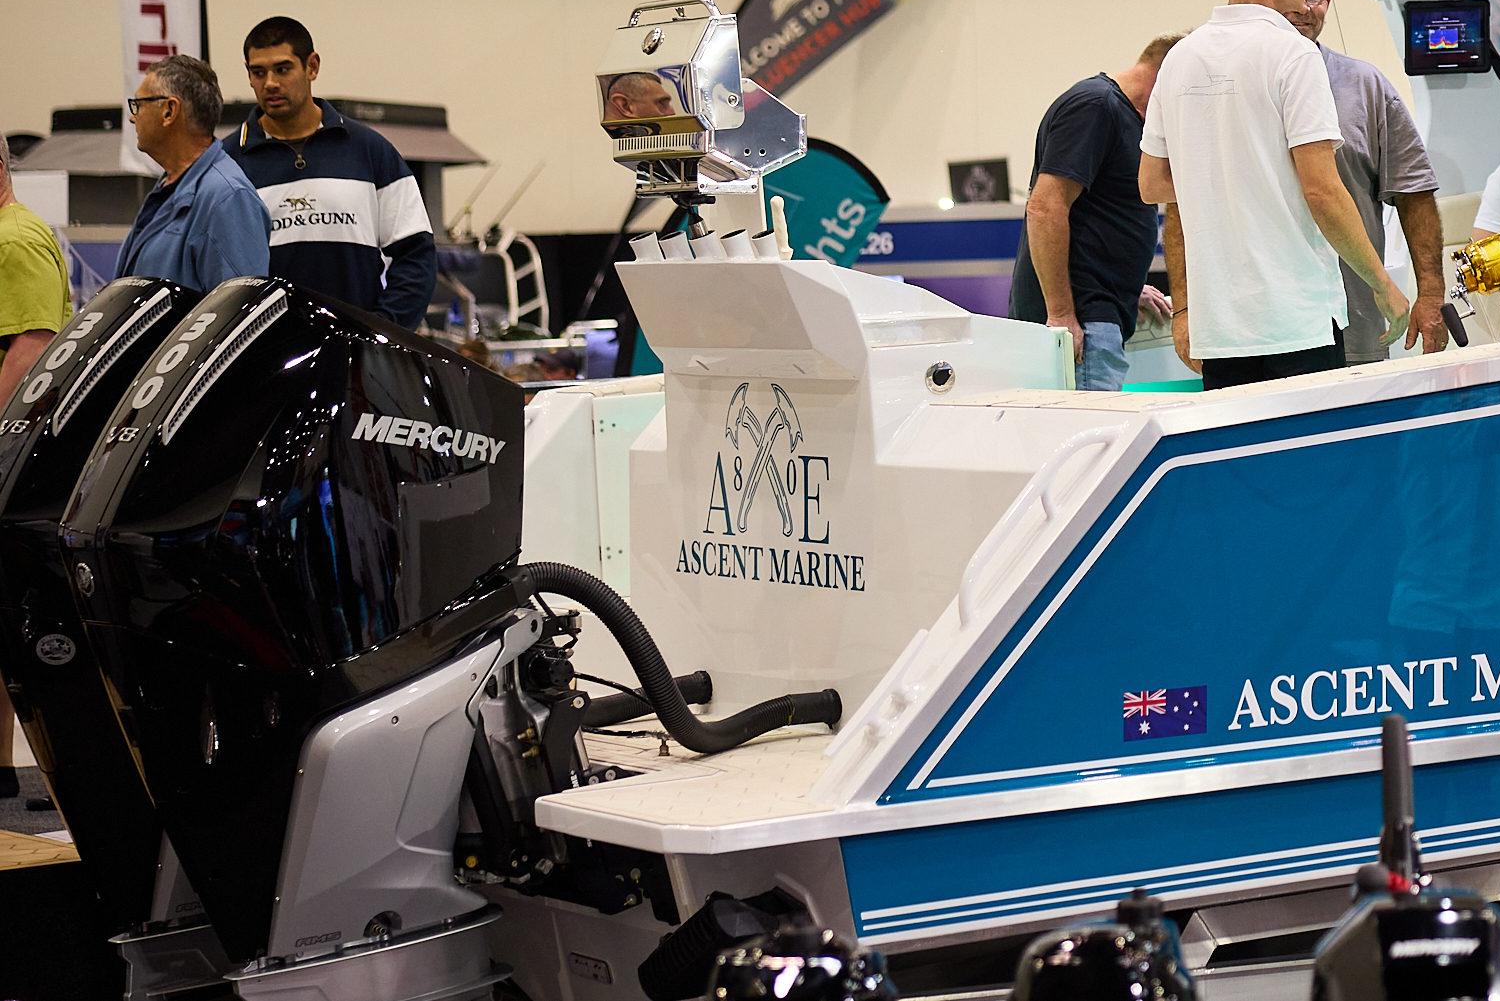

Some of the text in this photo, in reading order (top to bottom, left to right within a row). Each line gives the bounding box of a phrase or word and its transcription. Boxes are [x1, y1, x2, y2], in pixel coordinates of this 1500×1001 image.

[741, 17, 806, 77] LCOME
[756, 20, 842, 92] LUENCER
[308, 212, 355, 225] GUNN
[804, 197, 866, 265] hts
[131, 312, 218, 410] 300
[351, 412, 507, 465] MERCURY
[675, 538, 866, 592] ASCENT MARINE
[1227, 656, 1458, 731] ASCENT
